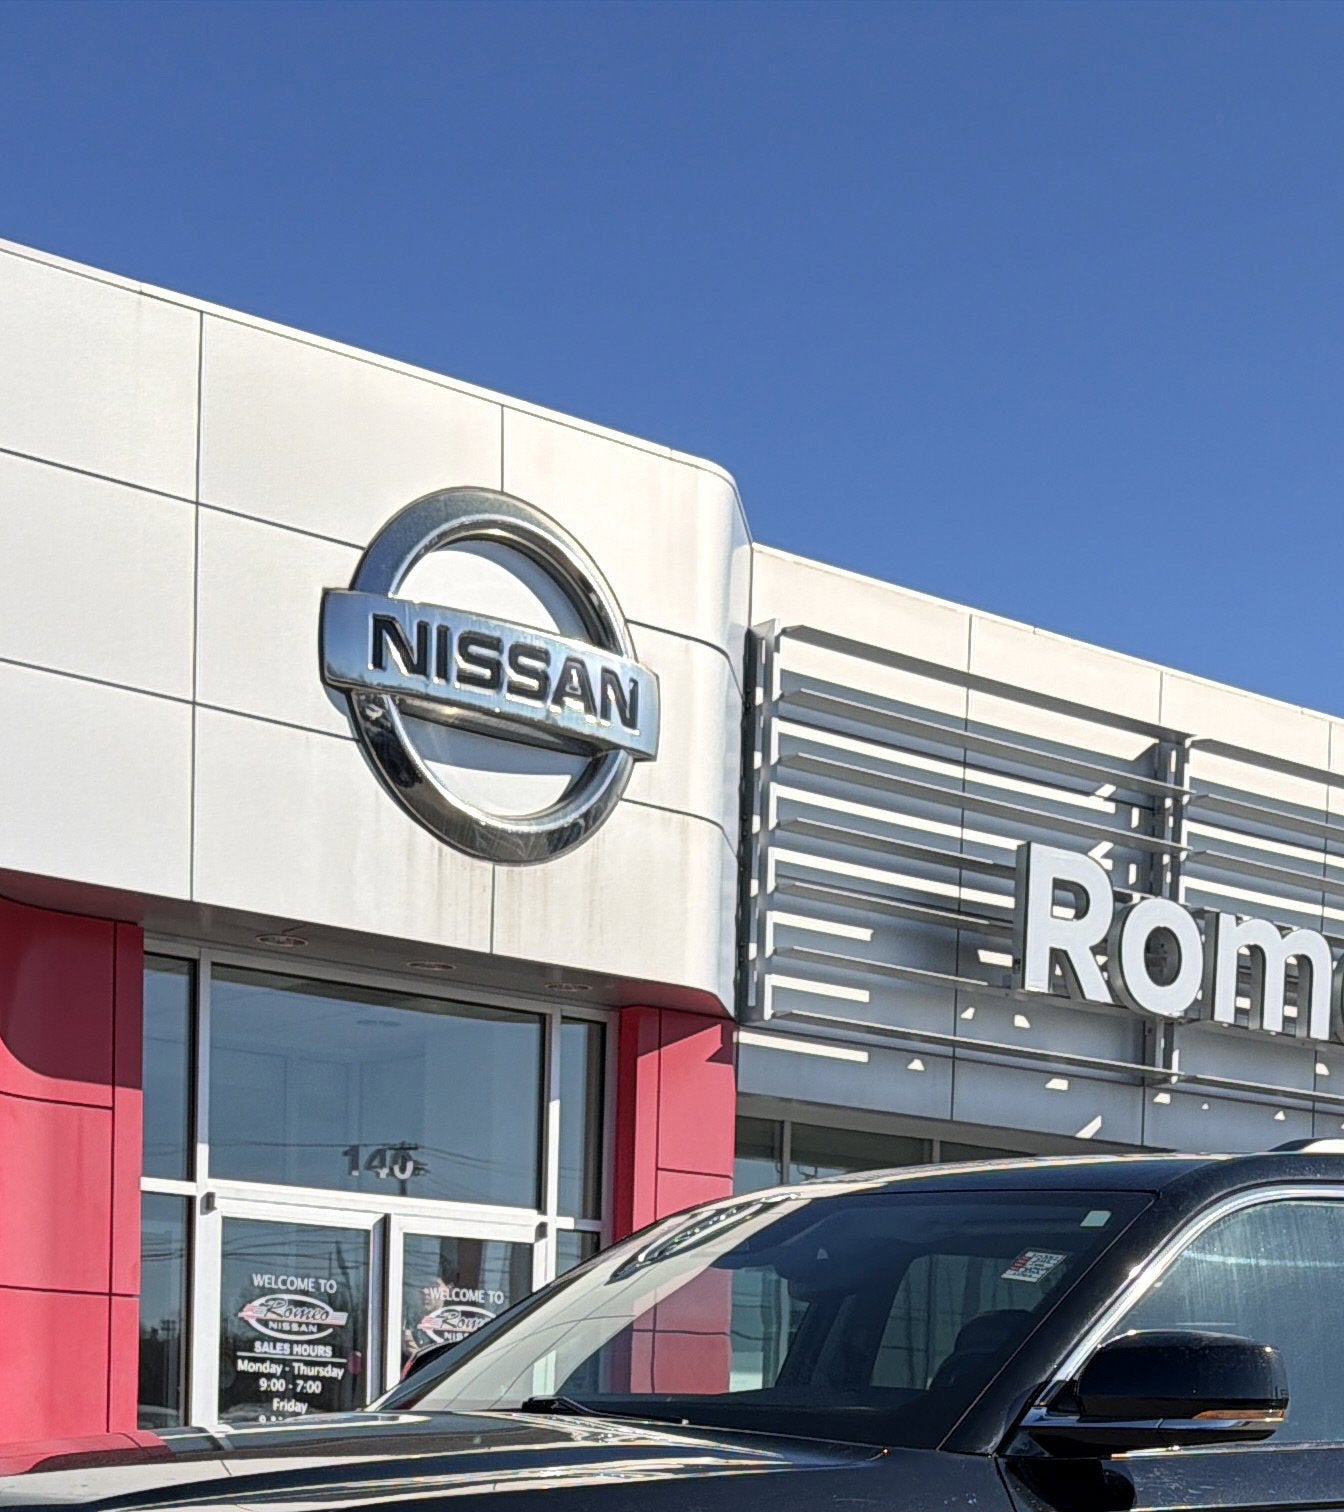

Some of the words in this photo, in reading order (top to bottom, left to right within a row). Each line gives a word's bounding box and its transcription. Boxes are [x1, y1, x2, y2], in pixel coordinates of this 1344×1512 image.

[367, 612, 641, 736] NISSAN
[341, 1145, 414, 1180] 140
[252, 1274, 315, 1292] WELCOME
[318, 1280, 337, 1293] TO
[429, 1287, 485, 1304] WELCOME
[488, 1290, 504, 1305] TO
[259, 1298, 329, 1321] Romeo
[268, 1321, 318, 1333] NISSAN
[254, 1341, 290, 1355] SALES
[292, 1344, 333, 1358] HOURS
[237, 1359, 283, 1376] Monday
[292, 1362, 345, 1380] Thursday
[258, 1378, 286, 1391] 9:00
[296, 1380, 322, 1394] 7:00
[272, 1398, 308, 1414] Friday
